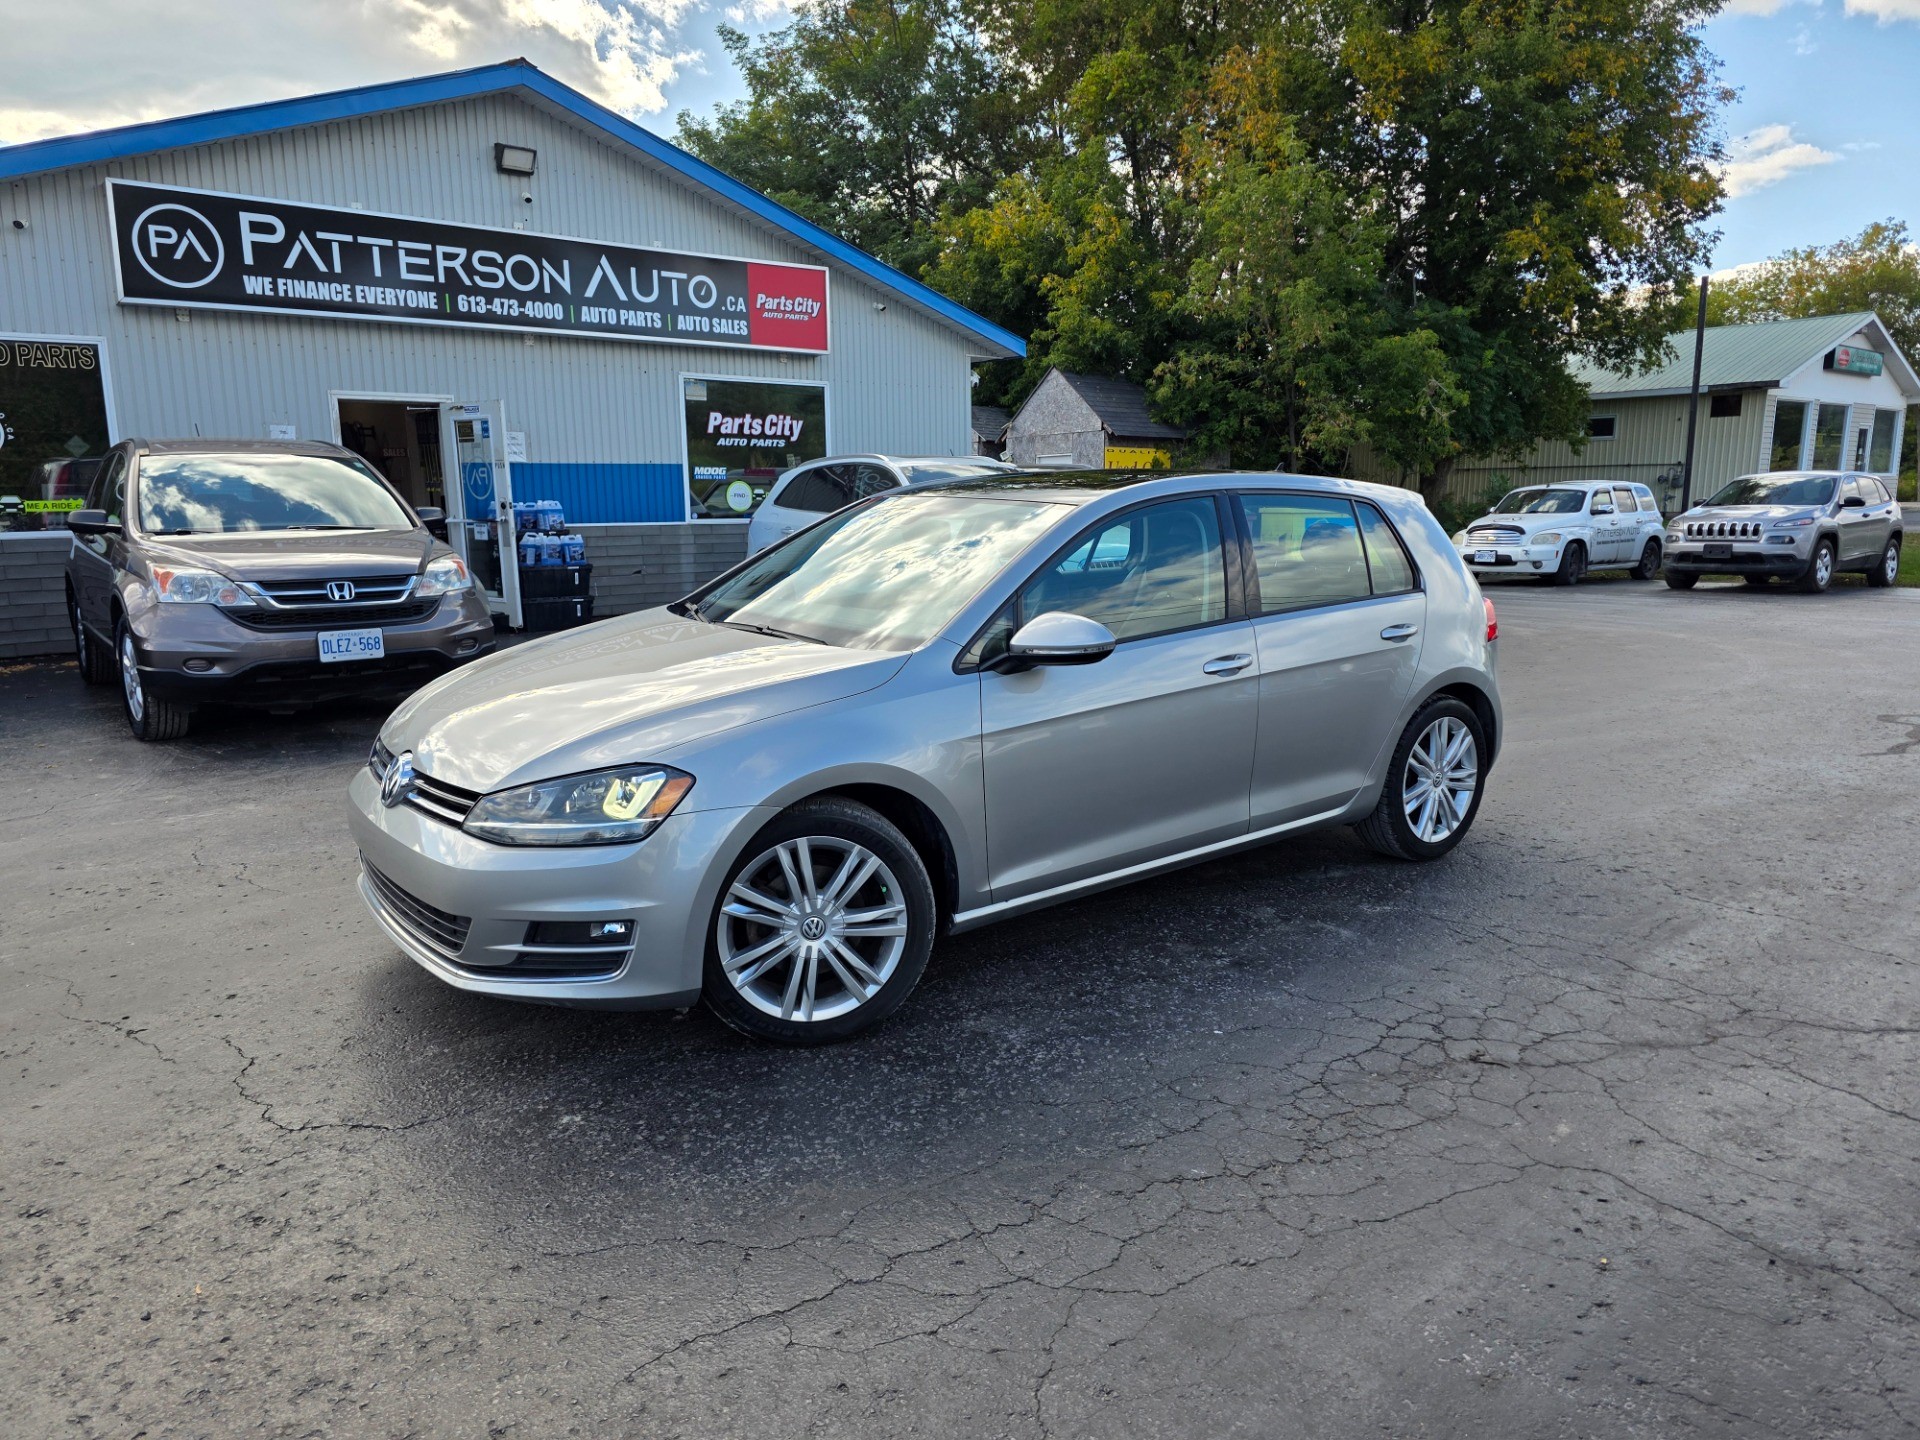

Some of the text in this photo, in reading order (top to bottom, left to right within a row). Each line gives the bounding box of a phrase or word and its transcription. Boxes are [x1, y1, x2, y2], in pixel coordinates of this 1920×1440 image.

[148, 224, 212, 263] PA
[238, 211, 572, 295] PATTERSON
[243, 275, 749, 336] WE FINANCE EVERYONE 613-473-4000 AUTO PARTS AUTO SALES
[762, 311, 809, 321] AUTO PARTS
[15, 342, 95, 370] PARTS
[717, 438, 786, 447] AUTO PARTS
[383, 448, 406, 457] SALES
[694, 467, 727, 475] MOOG
[322, 636, 380, 654] DLEZ 568
